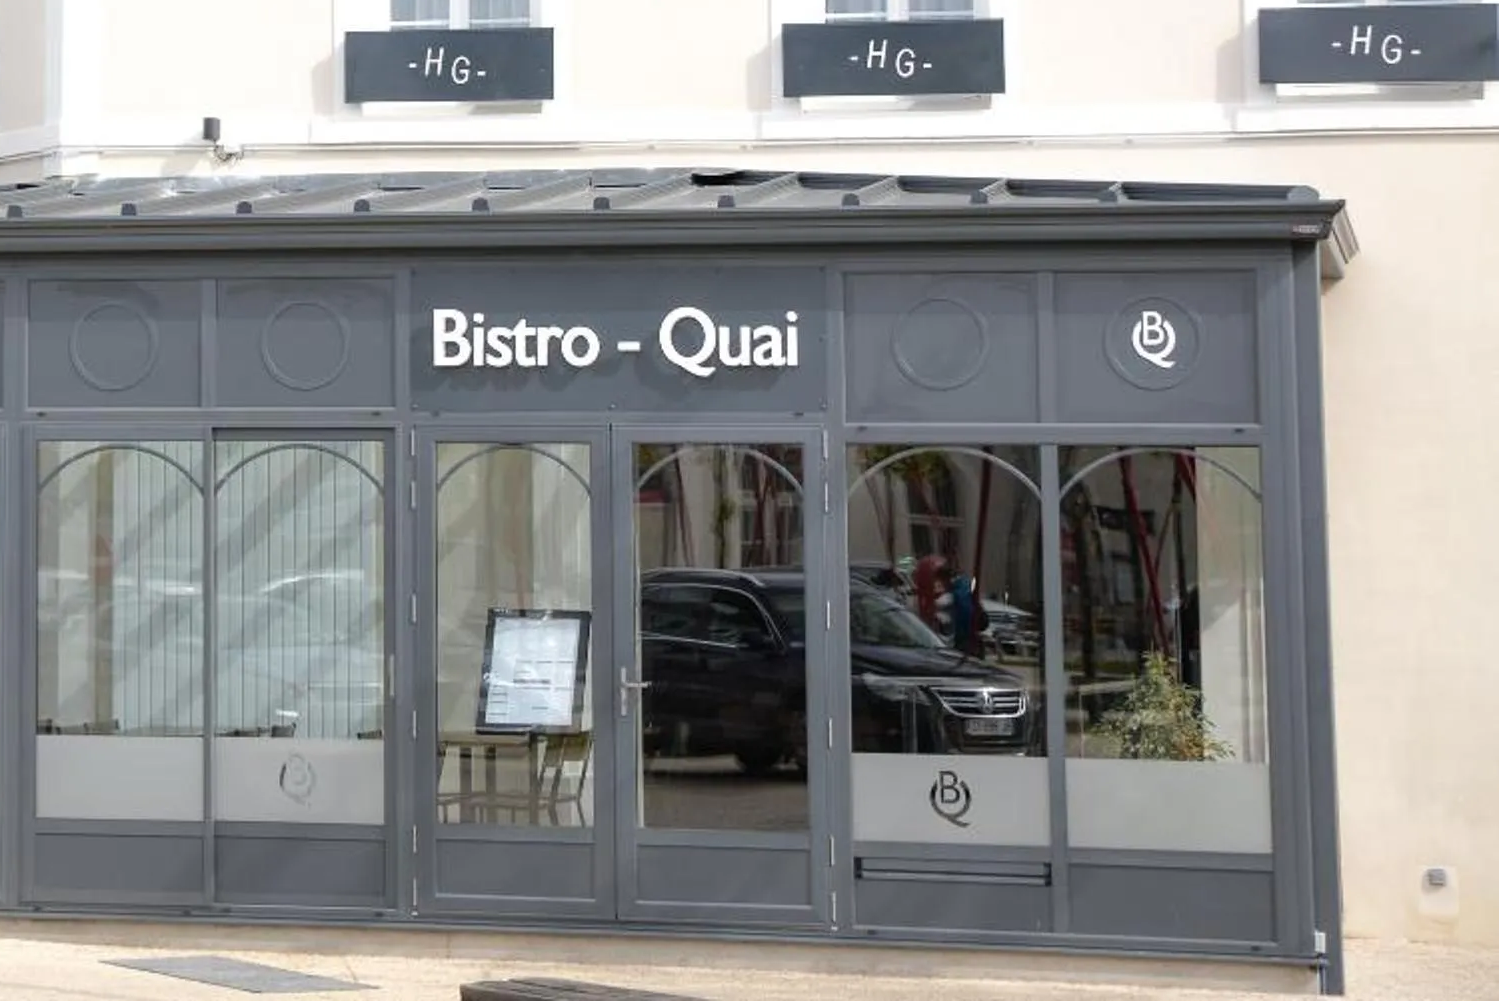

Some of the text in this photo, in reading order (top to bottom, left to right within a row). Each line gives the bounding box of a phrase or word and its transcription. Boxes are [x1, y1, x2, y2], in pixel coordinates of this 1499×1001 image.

[432, 306, 799, 378] Bistro - Quai
